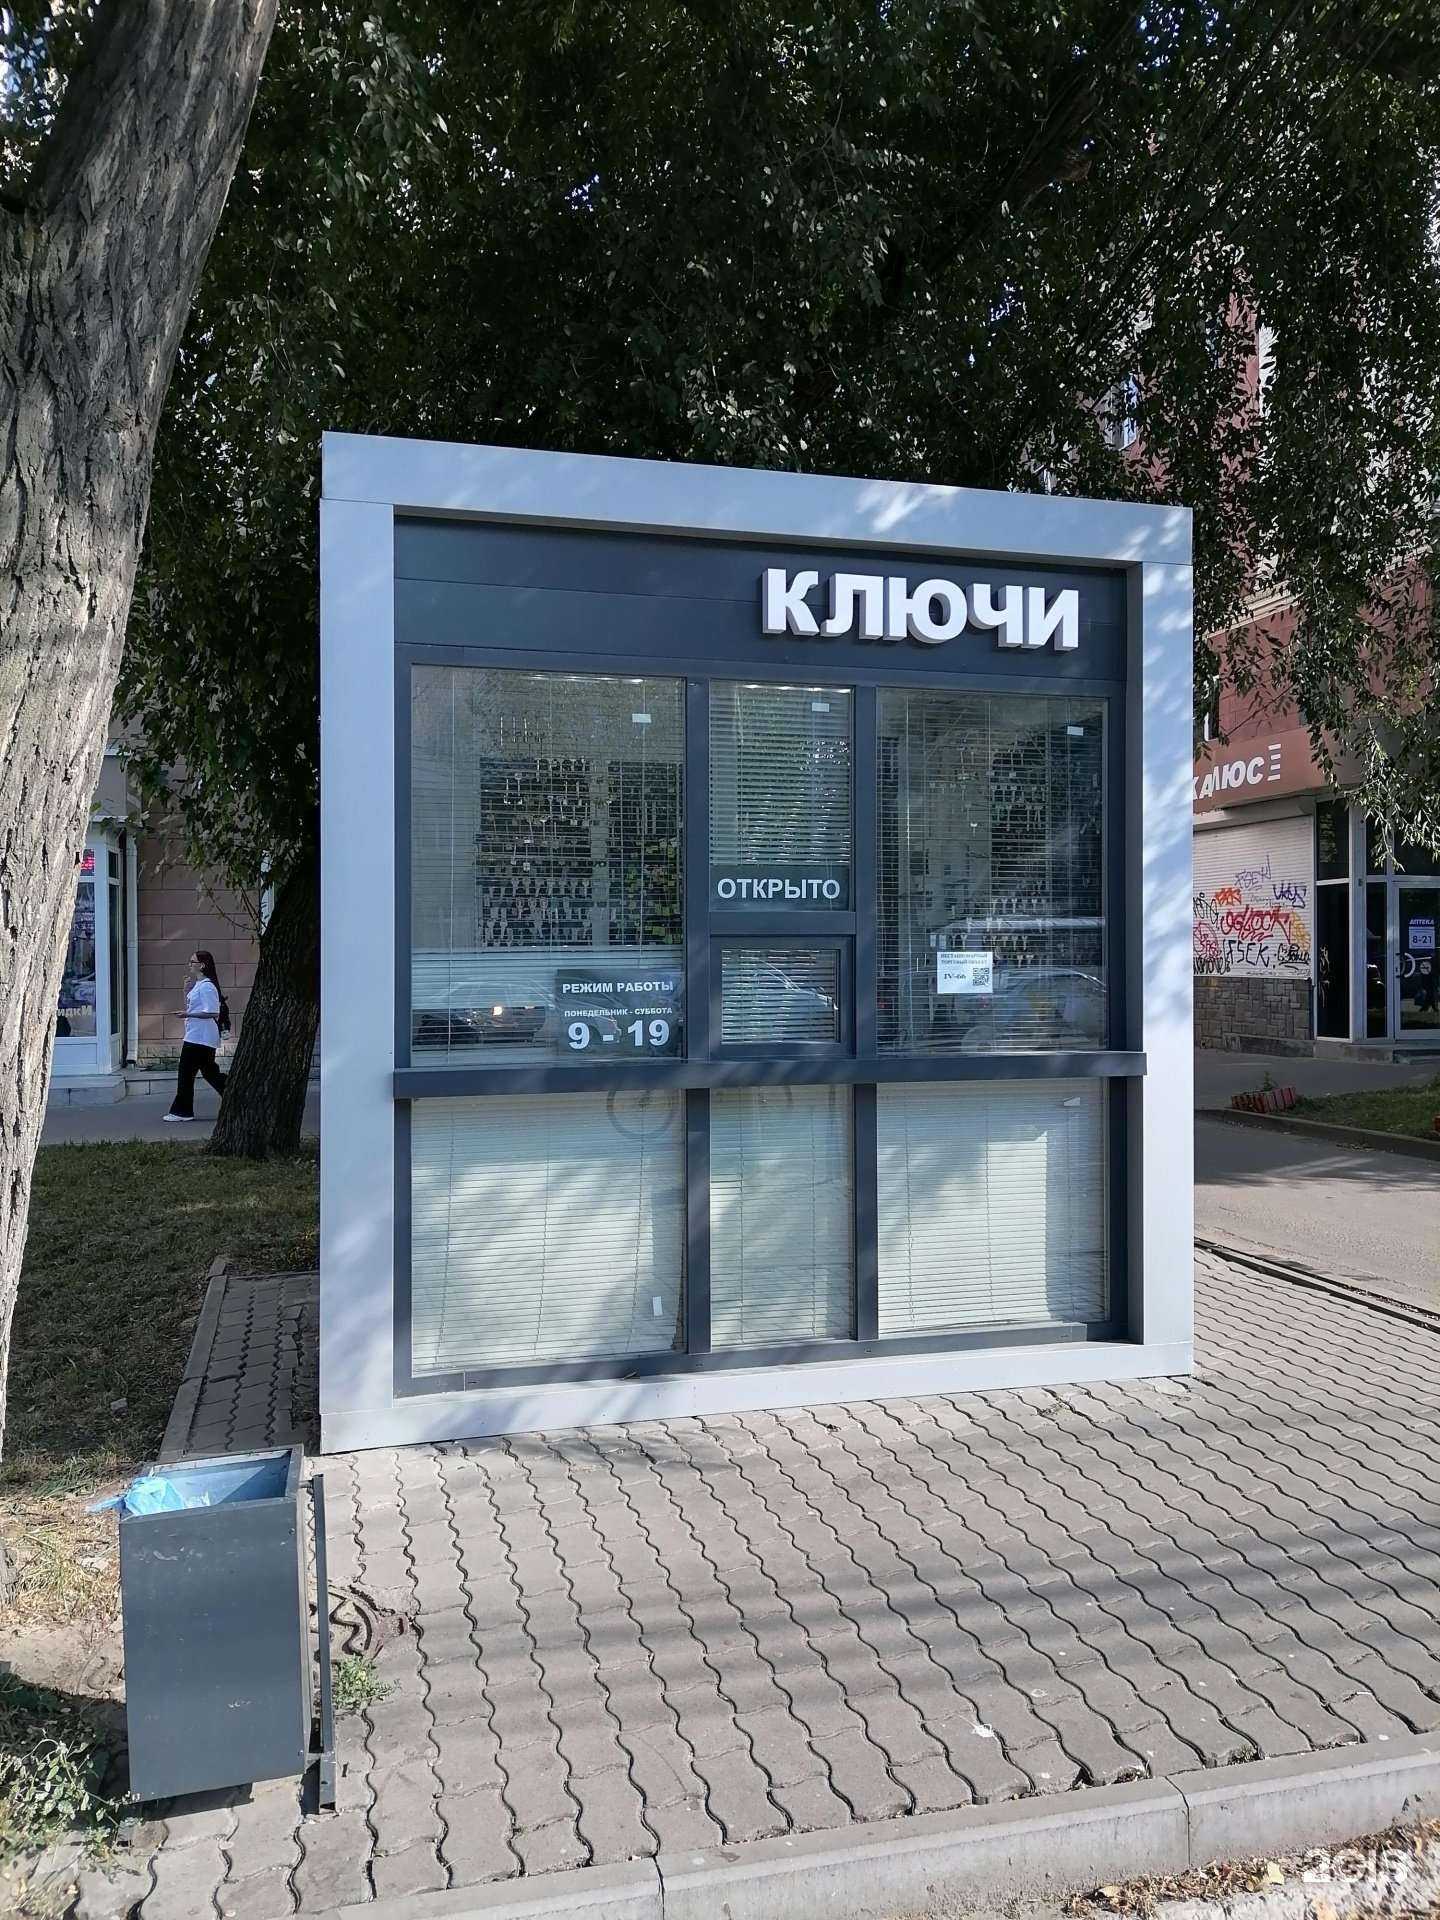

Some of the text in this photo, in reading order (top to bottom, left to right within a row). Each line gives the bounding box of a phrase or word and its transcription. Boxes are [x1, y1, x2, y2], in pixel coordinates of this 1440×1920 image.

[762, 568, 1079, 652] КЛЮЧИ
[717, 878, 841, 899] ОТКРЫТО
[562, 980, 674, 994] РЕЖИМ РАБОТЫ
[564, 1008, 628, 1018] ПОНЕДЕЛЬНИК
[634, 1007, 673, 1016] СУББОТА
[567, 1022, 590, 1050] 9
[627, 1019, 670, 1047] 19
